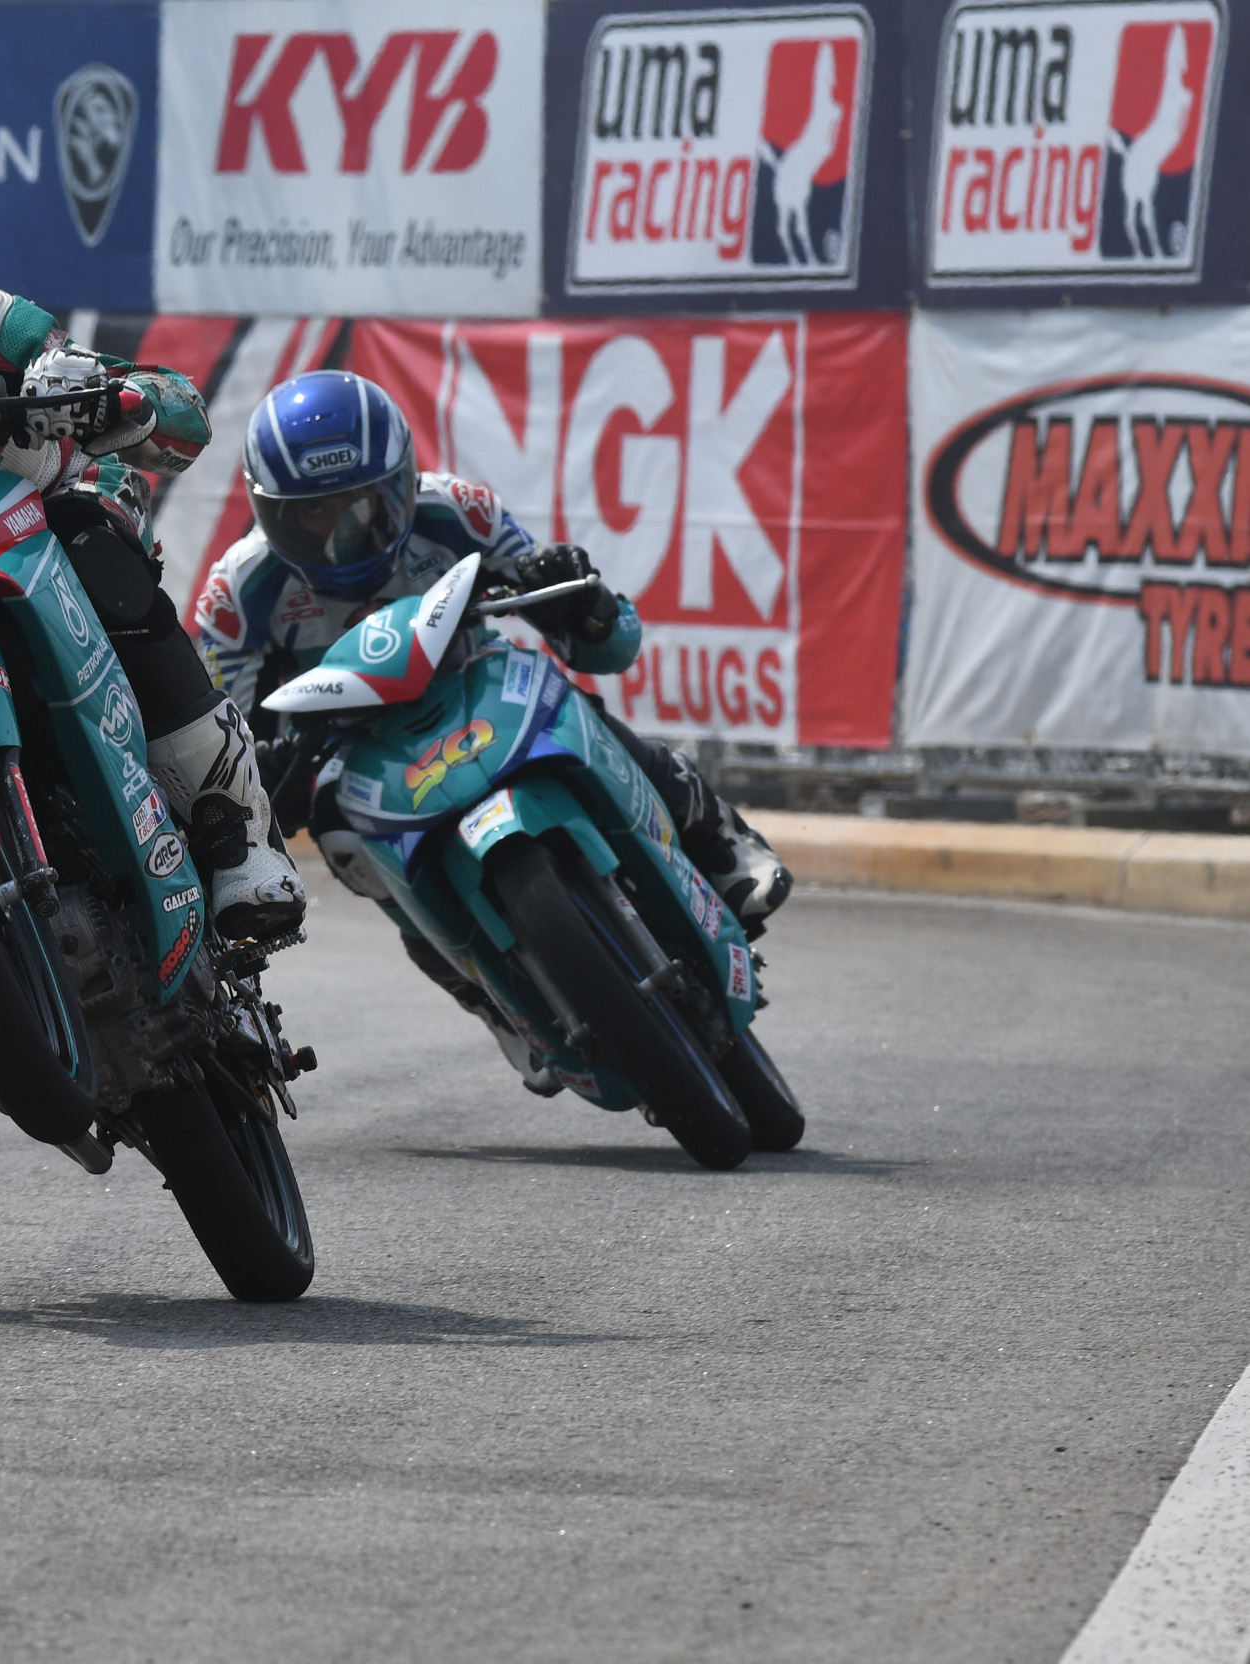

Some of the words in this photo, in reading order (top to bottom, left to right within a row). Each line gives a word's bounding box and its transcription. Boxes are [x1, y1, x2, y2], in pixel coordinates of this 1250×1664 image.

[214, 29, 500, 176] KYB
[595, 42, 723, 139] uma
[949, 23, 1073, 129] uma
[586, 139, 751, 262] racing
[940, 124, 1104, 255] racing
[170, 216, 216, 269] Our
[222, 219, 337, 271] Precision,
[349, 219, 398, 268] Your
[402, 219, 527, 282] Advantage
[307, 448, 352, 471] SHOEI
[456, 330, 792, 622] NGK
[3, 502, 44, 537] YAMAHA
[76, 636, 109, 686] PETRONAS
[618, 643, 784, 727] PLUGS
[122, 767, 148, 802] RCB
[154, 838, 180, 871] ARC
[162, 886, 200, 912] GALFER
[158, 928, 191, 983] KOSO
